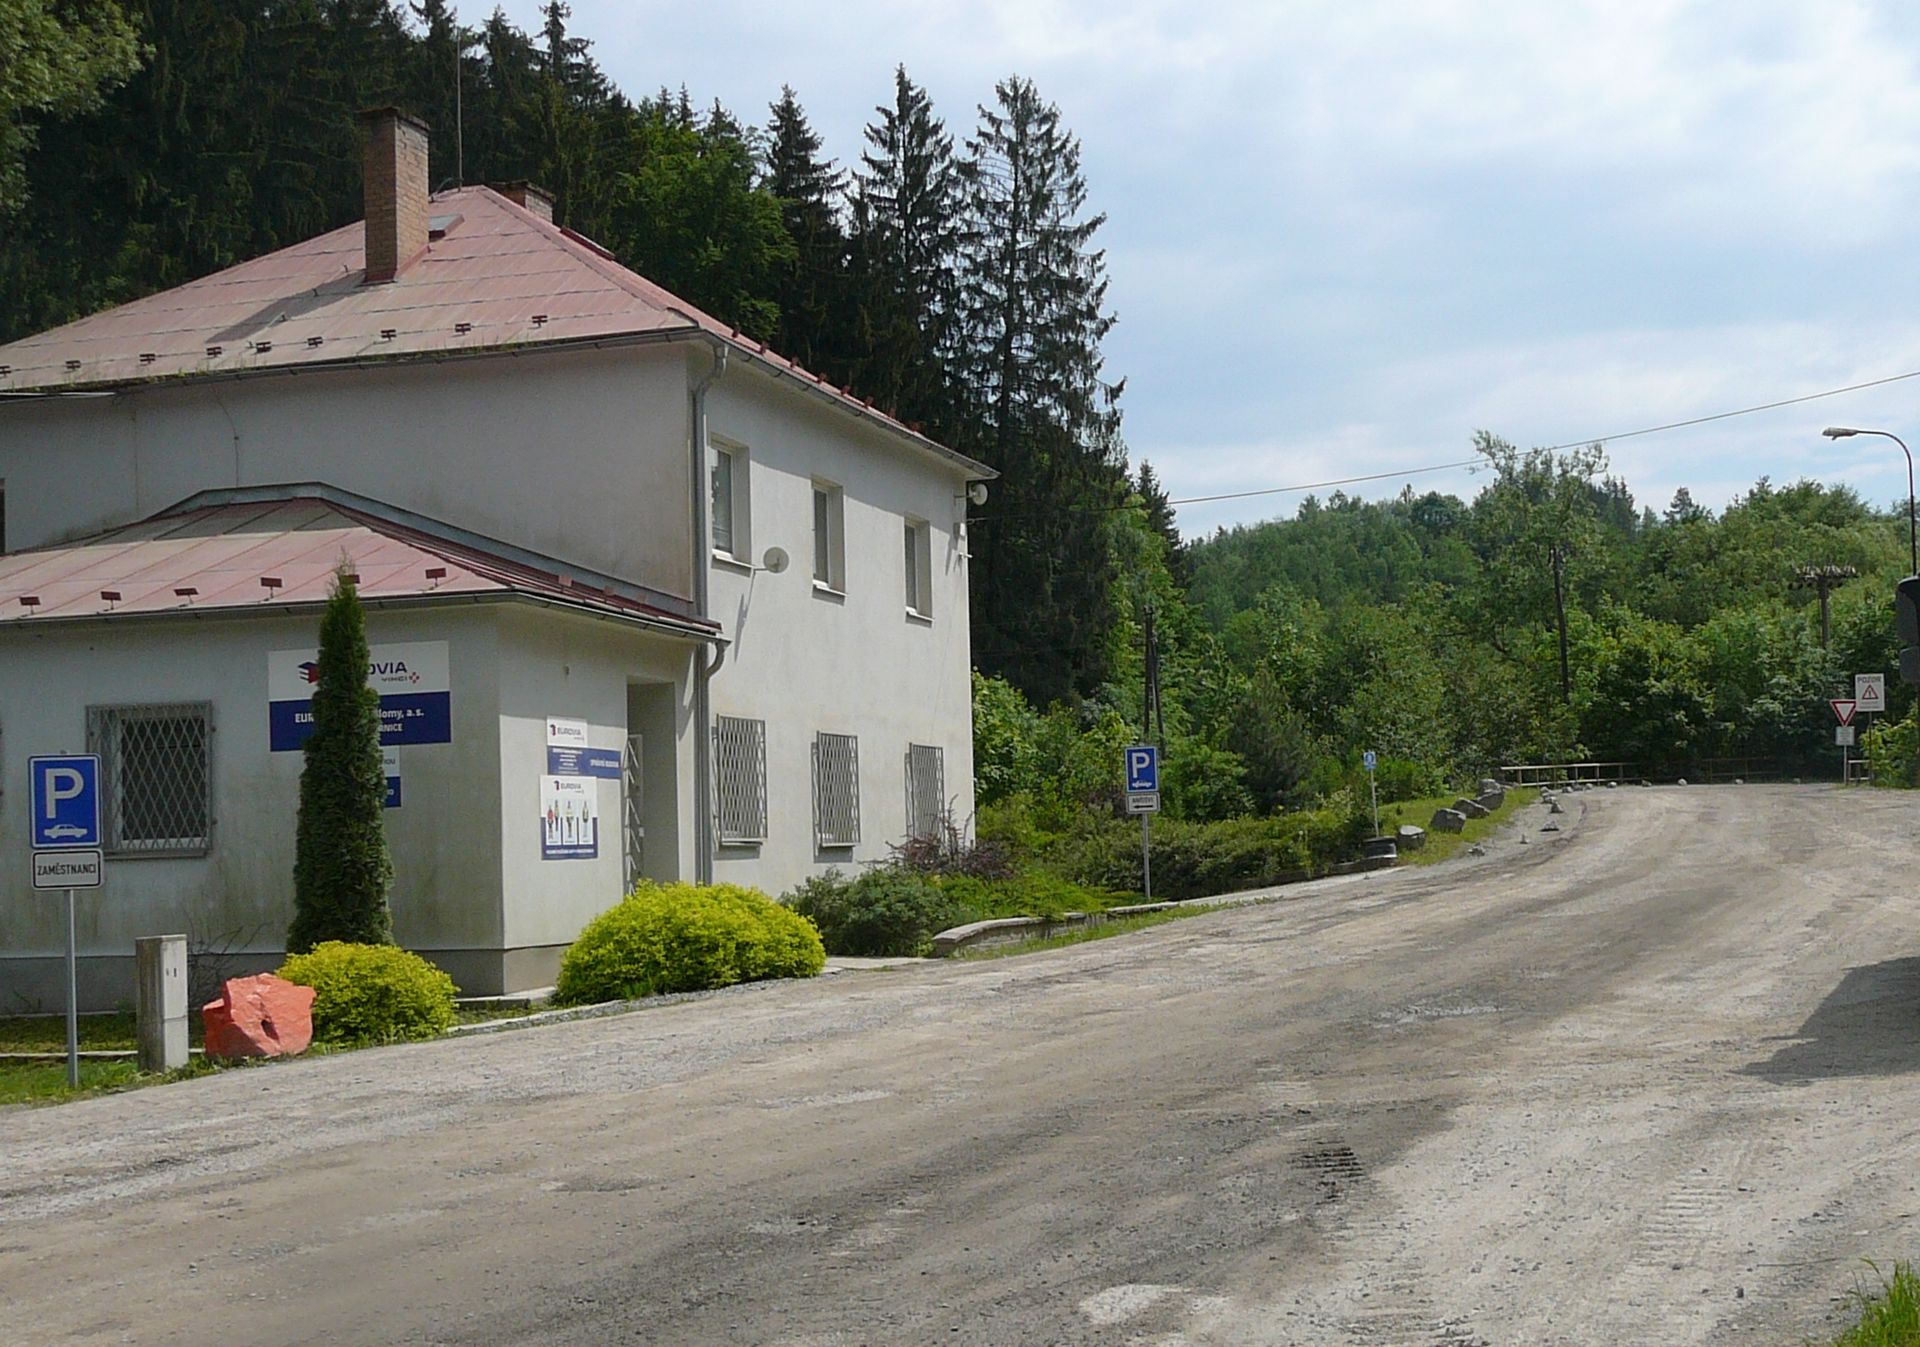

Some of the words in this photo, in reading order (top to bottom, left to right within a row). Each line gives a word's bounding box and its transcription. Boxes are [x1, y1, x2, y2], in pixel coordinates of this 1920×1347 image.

[368, 661, 408, 675] OVIA
[1131, 752, 1150, 778] P
[45, 768, 84, 819] P
[37, 862, 97, 876] ZAMĚSTNANCI
